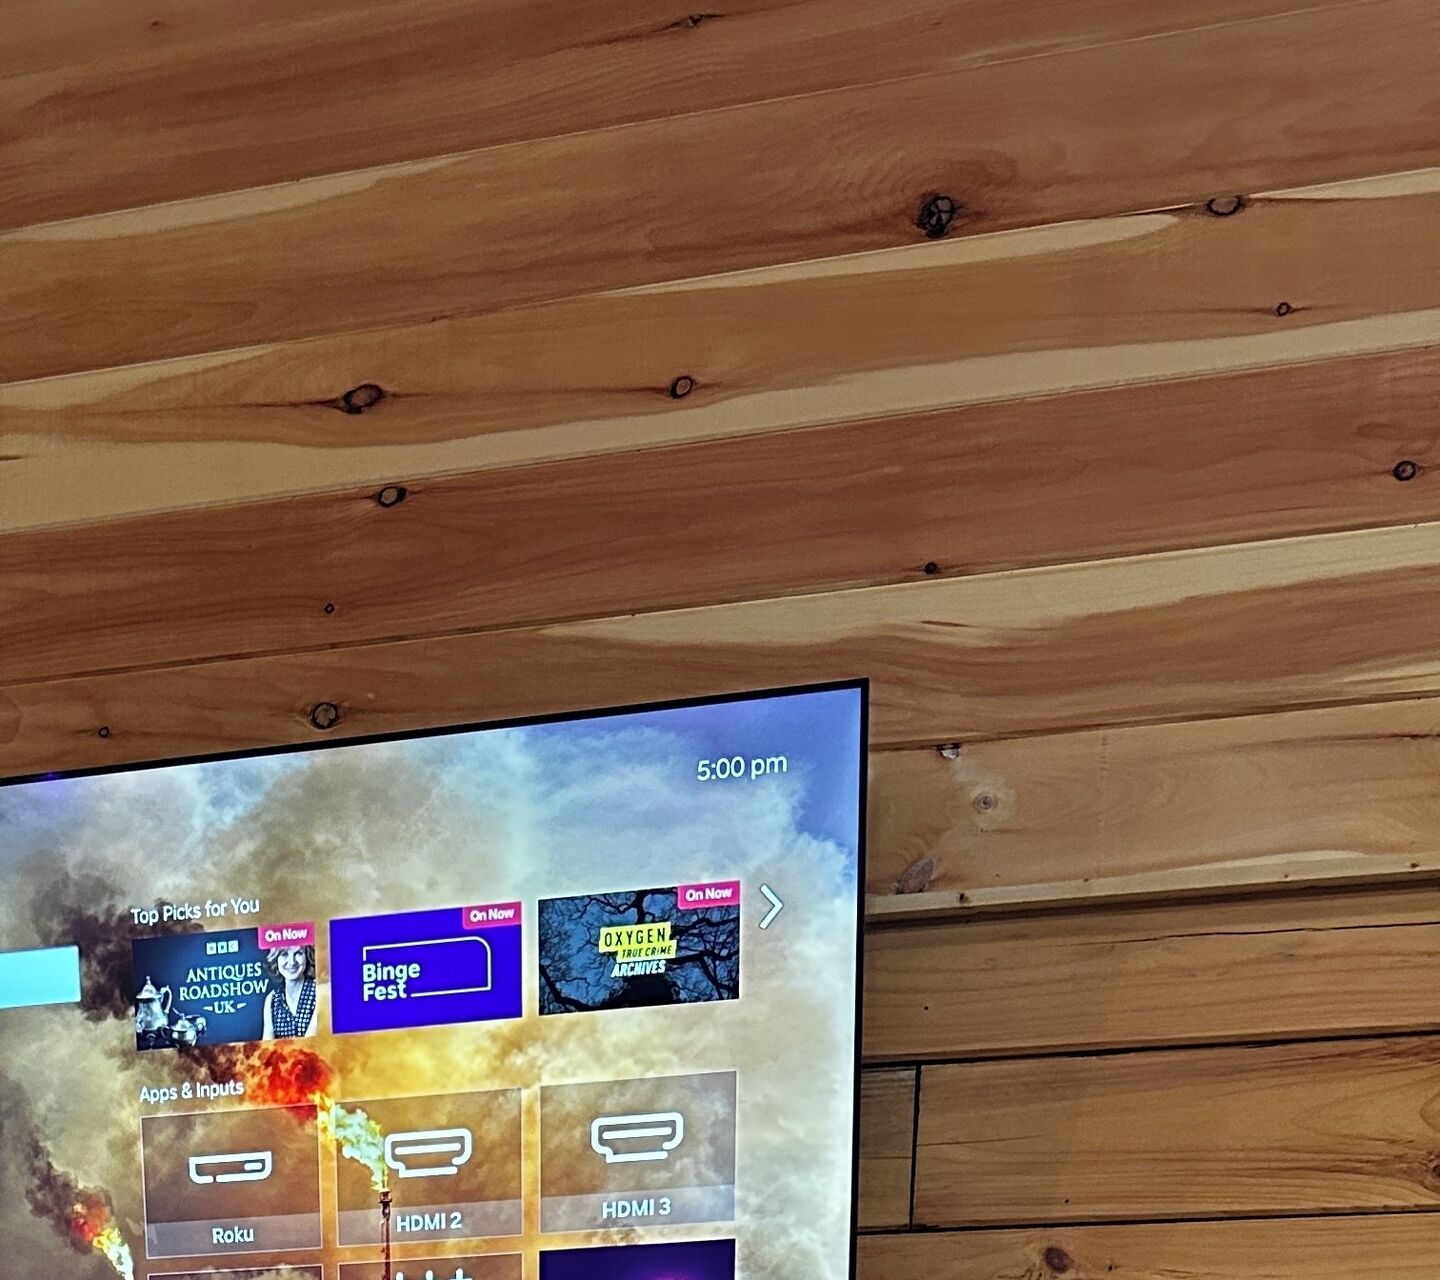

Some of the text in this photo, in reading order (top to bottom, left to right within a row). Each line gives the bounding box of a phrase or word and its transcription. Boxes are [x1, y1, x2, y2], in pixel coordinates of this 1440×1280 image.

[697, 755, 788, 781] 5:00 pm
[685, 887, 733, 902] On Now
[131, 898, 260, 926] Top Picks for You
[469, 908, 515, 923] On Now
[265, 928, 308, 942] On Now
[604, 927, 666, 947] OXYGEN
[622, 945, 672, 959] TRUE CRIME
[186, 962, 262, 983] ANTIQUES
[362, 962, 421, 983] Binge
[611, 960, 666, 978] ARCHIVES
[179, 978, 269, 1001] ROADSHOW
[363, 981, 407, 1002] Fest
[139, 1080, 244, 1104] Apps & Inputs
[602, 1197, 671, 1219] HDMI 3
[396, 1212, 462, 1232] HDMI 2
[212, 1226, 254, 1244] Roku
